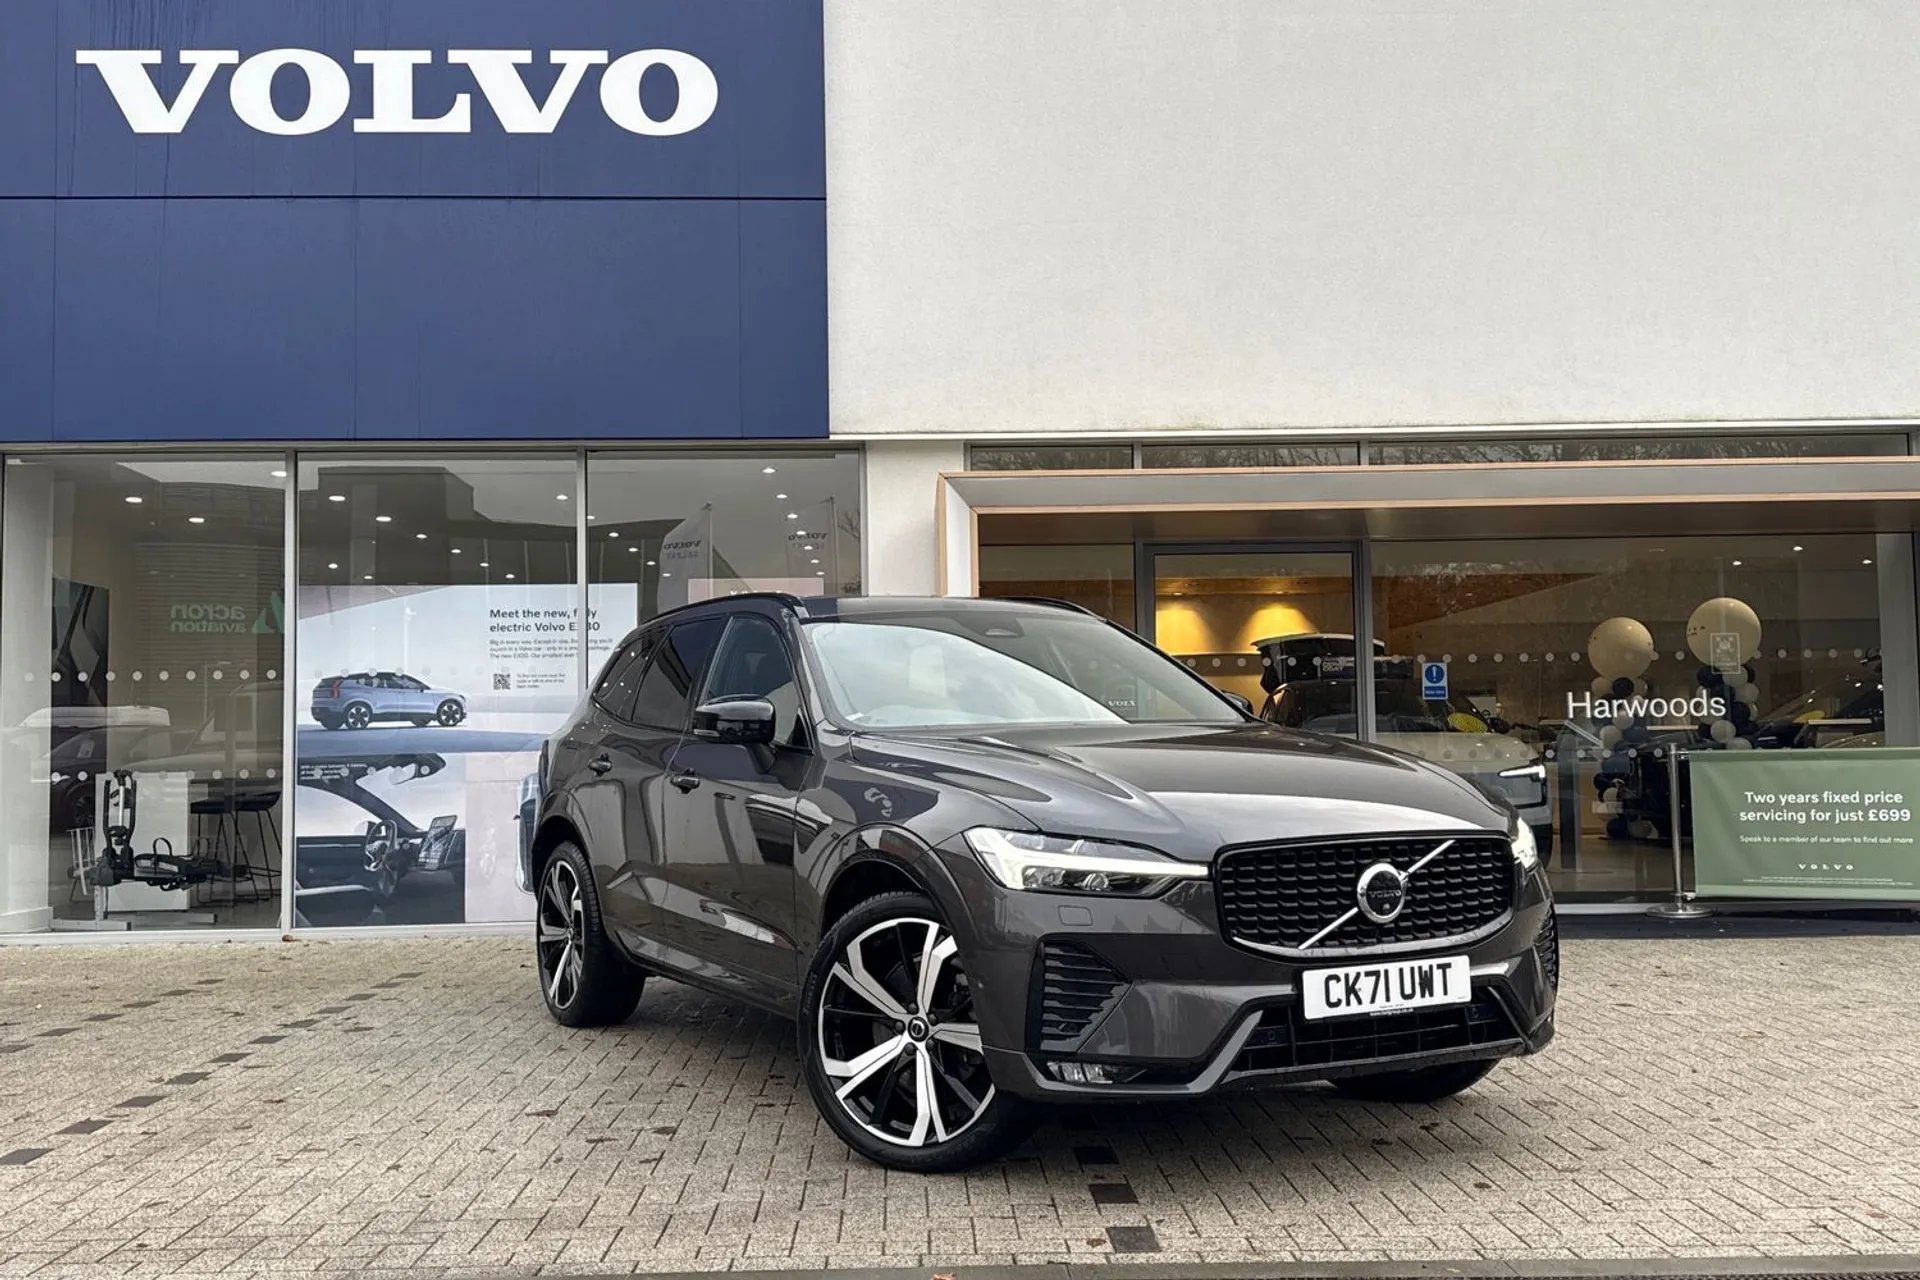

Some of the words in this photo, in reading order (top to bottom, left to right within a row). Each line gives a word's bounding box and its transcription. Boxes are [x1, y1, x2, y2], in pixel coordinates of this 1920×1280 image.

[75, 48, 719, 136] VOLVO
[490, 609, 519, 619] Meet
[522, 609, 541, 618] the
[544, 610, 570, 619] new,
[573, 608, 598, 619] fly
[490, 622, 532, 632] electric
[534, 622, 566, 632] Volvo
[569, 621, 601, 632] E30
[1566, 689, 1727, 718] Harwoods
[1744, 791, 1776, 804] Two
[1778, 793, 1819, 806] years
[1822, 791, 1860, 804] fixed
[1864, 791, 1903, 806] price
[1739, 809, 1806, 824] servicing
[1810, 809, 1832, 821] for
[1835, 809, 1864, 824] just
[1867, 808, 1911, 822] £699
[1739, 835, 1762, 844] Speak
[1778, 835, 1809, 844] member
[1810, 836, 1818, 844] of
[1833, 836, 1852, 844] team
[1853, 836, 1862, 844] to
[1862, 836, 1877, 844] find
[1879, 836, 1892, 844] out
[1798, 863, 1854, 871] VOLVO
[1368, 889, 1402, 898] VOLVO
[1324, 968, 1391, 1009] CK71
[1399, 962, 1452, 1001] UWT
